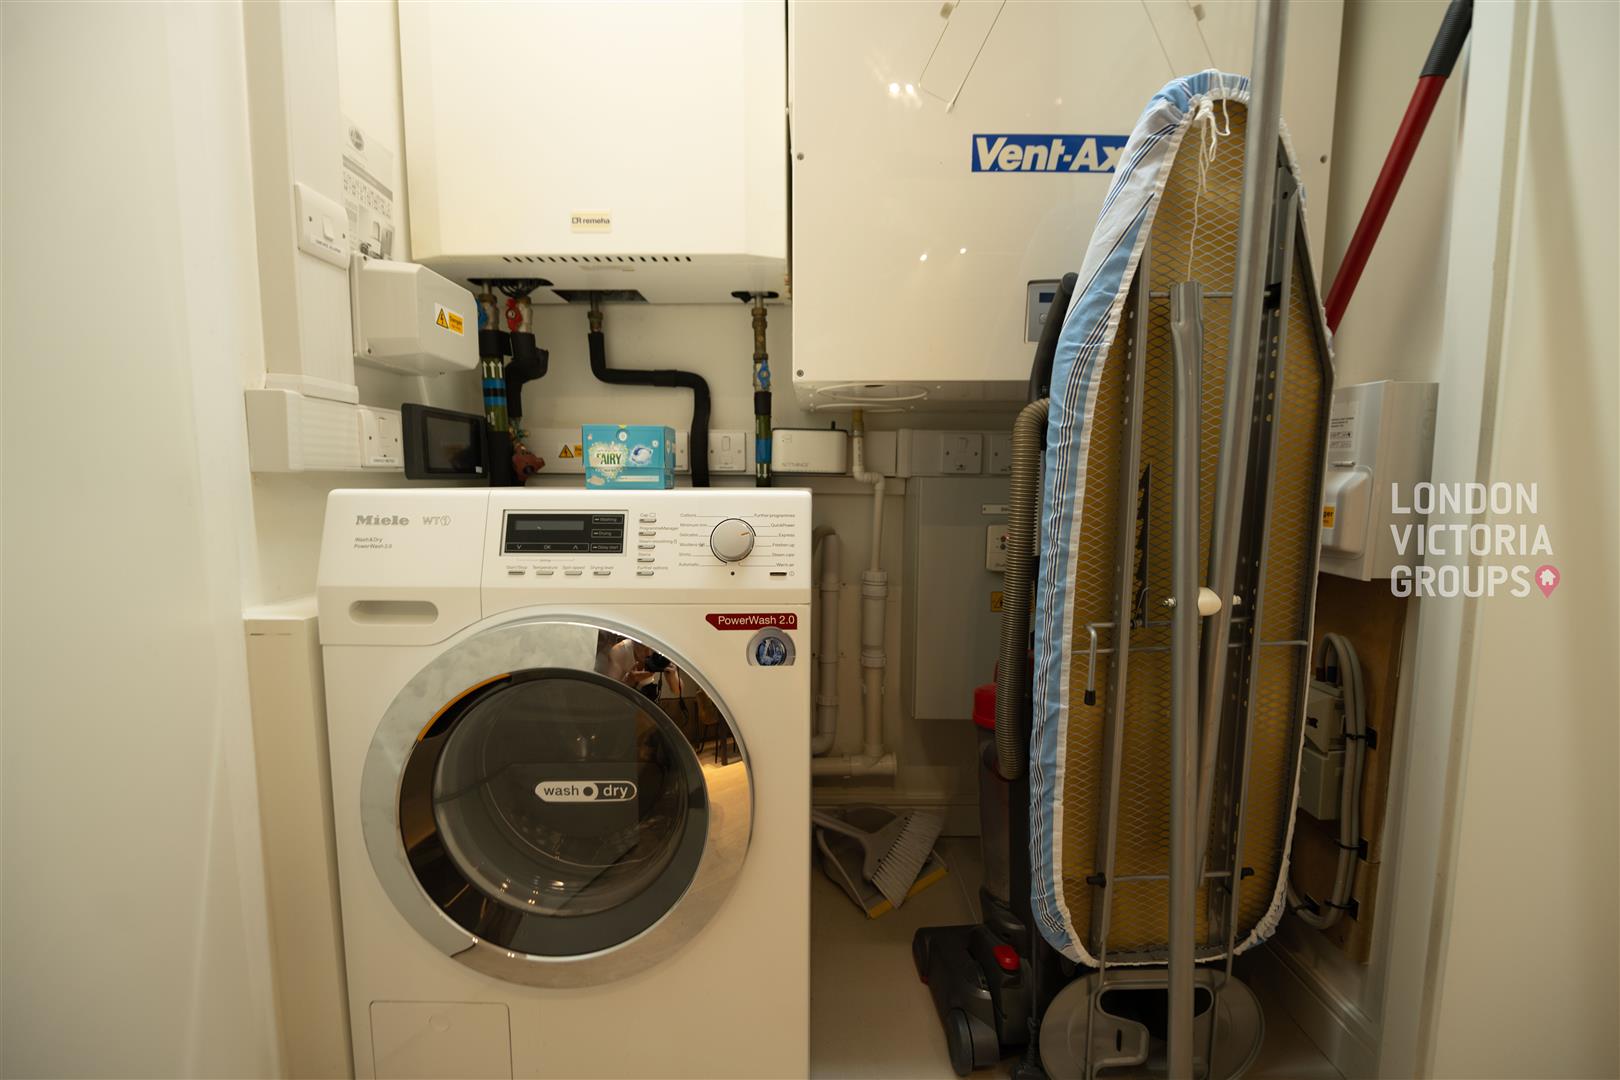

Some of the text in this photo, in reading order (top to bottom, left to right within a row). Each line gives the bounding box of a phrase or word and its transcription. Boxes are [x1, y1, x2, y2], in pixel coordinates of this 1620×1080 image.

[355, 514, 410, 526] Miele
[718, 615, 795, 626] PowerWash 2.0
[544, 784, 628, 799] wash dry
